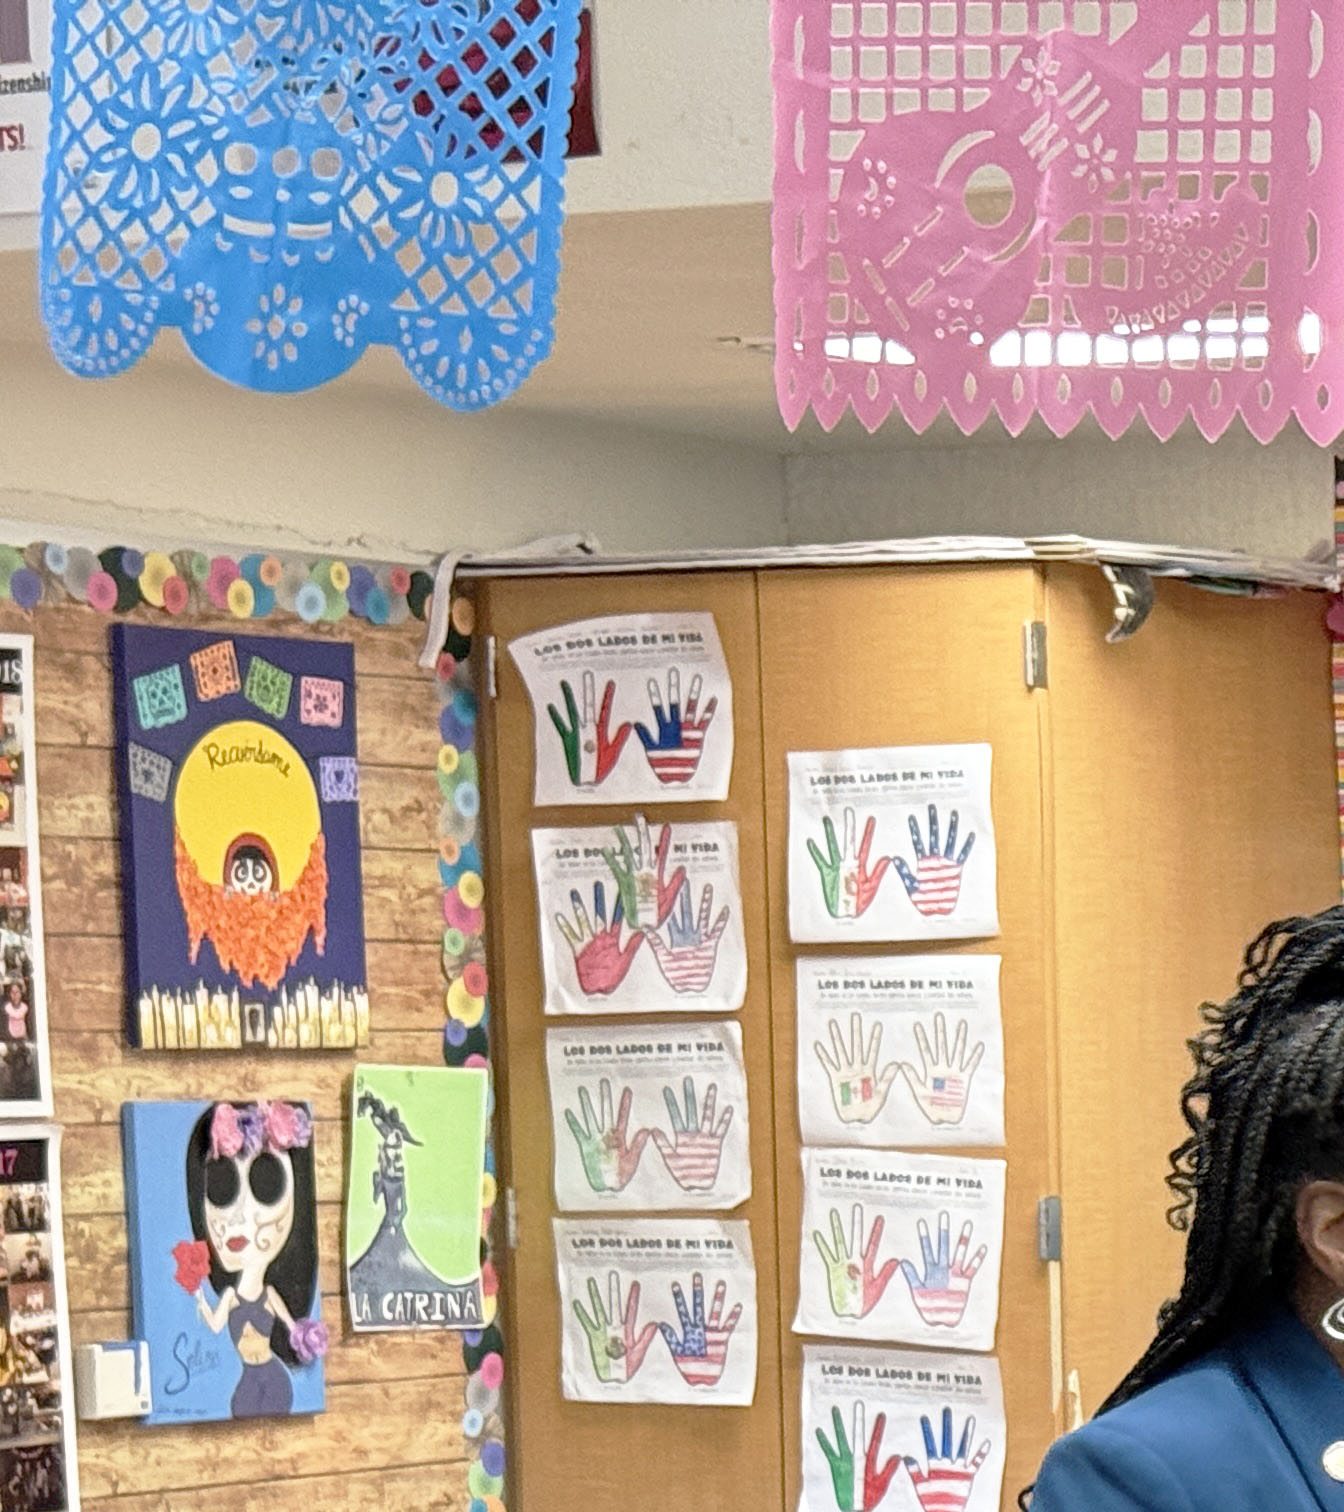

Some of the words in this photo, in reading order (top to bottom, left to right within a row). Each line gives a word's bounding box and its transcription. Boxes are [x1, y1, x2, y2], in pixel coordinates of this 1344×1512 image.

[534, 644, 562, 656] LOS
[566, 639, 594, 649] DOS
[598, 635, 638, 647] LADOS
[642, 634, 657, 645] DE
[661, 633, 676, 643] MI
[679, 632, 703, 643] VIDA
[810, 775, 832, 786] LOS
[834, 774, 856, 785] DOS
[860, 772, 898, 783] LADOS
[902, 771, 916, 781] DE
[920, 771, 933, 780] MI
[937, 770, 964, 779] VIDA
[555, 848, 579, 859] LOS
[673, 843, 687, 853] MI
[691, 842, 719, 852] VIDA
[817, 979, 839, 990] LOS
[843, 979, 866, 989] DOS
[869, 979, 906, 990] LADOS
[909, 979, 924, 989] DE
[929, 979, 943, 989] MI
[946, 979, 974, 989] VIDA
[563, 1045, 585, 1056] LOS
[589, 1045, 612, 1055] DOS
[615, 1044, 653, 1055] LADOS
[657, 1043, 672, 1053] DE
[677, 1043, 692, 1053] MI
[695, 1042, 725, 1052] VIDA
[820, 1167, 842, 1178] LOS
[846, 1169, 869, 1180] DOS
[873, 1171, 912, 1183] LADOS
[916, 1175, 931, 1185] DE
[936, 1177, 950, 1186] MI
[955, 1177, 983, 1189] VIDA
[571, 1238, 595, 1249] LOS
[599, 1238, 622, 1248] DOS
[626, 1238, 663, 1249] LADOS
[666, 1238, 682, 1249] DE
[685, 1239, 700, 1249] MI
[704, 1239, 733, 1249] VIDA
[351, 1291, 372, 1323] LA
[382, 1290, 478, 1321] CATRINA
[821, 1364, 844, 1375] LOS
[848, 1366, 871, 1377] DOS
[875, 1368, 913, 1380] LADOS
[917, 1370, 932, 1382] DE
[936, 1372, 950, 1382] MI
[954, 1374, 982, 1385] VIDA
